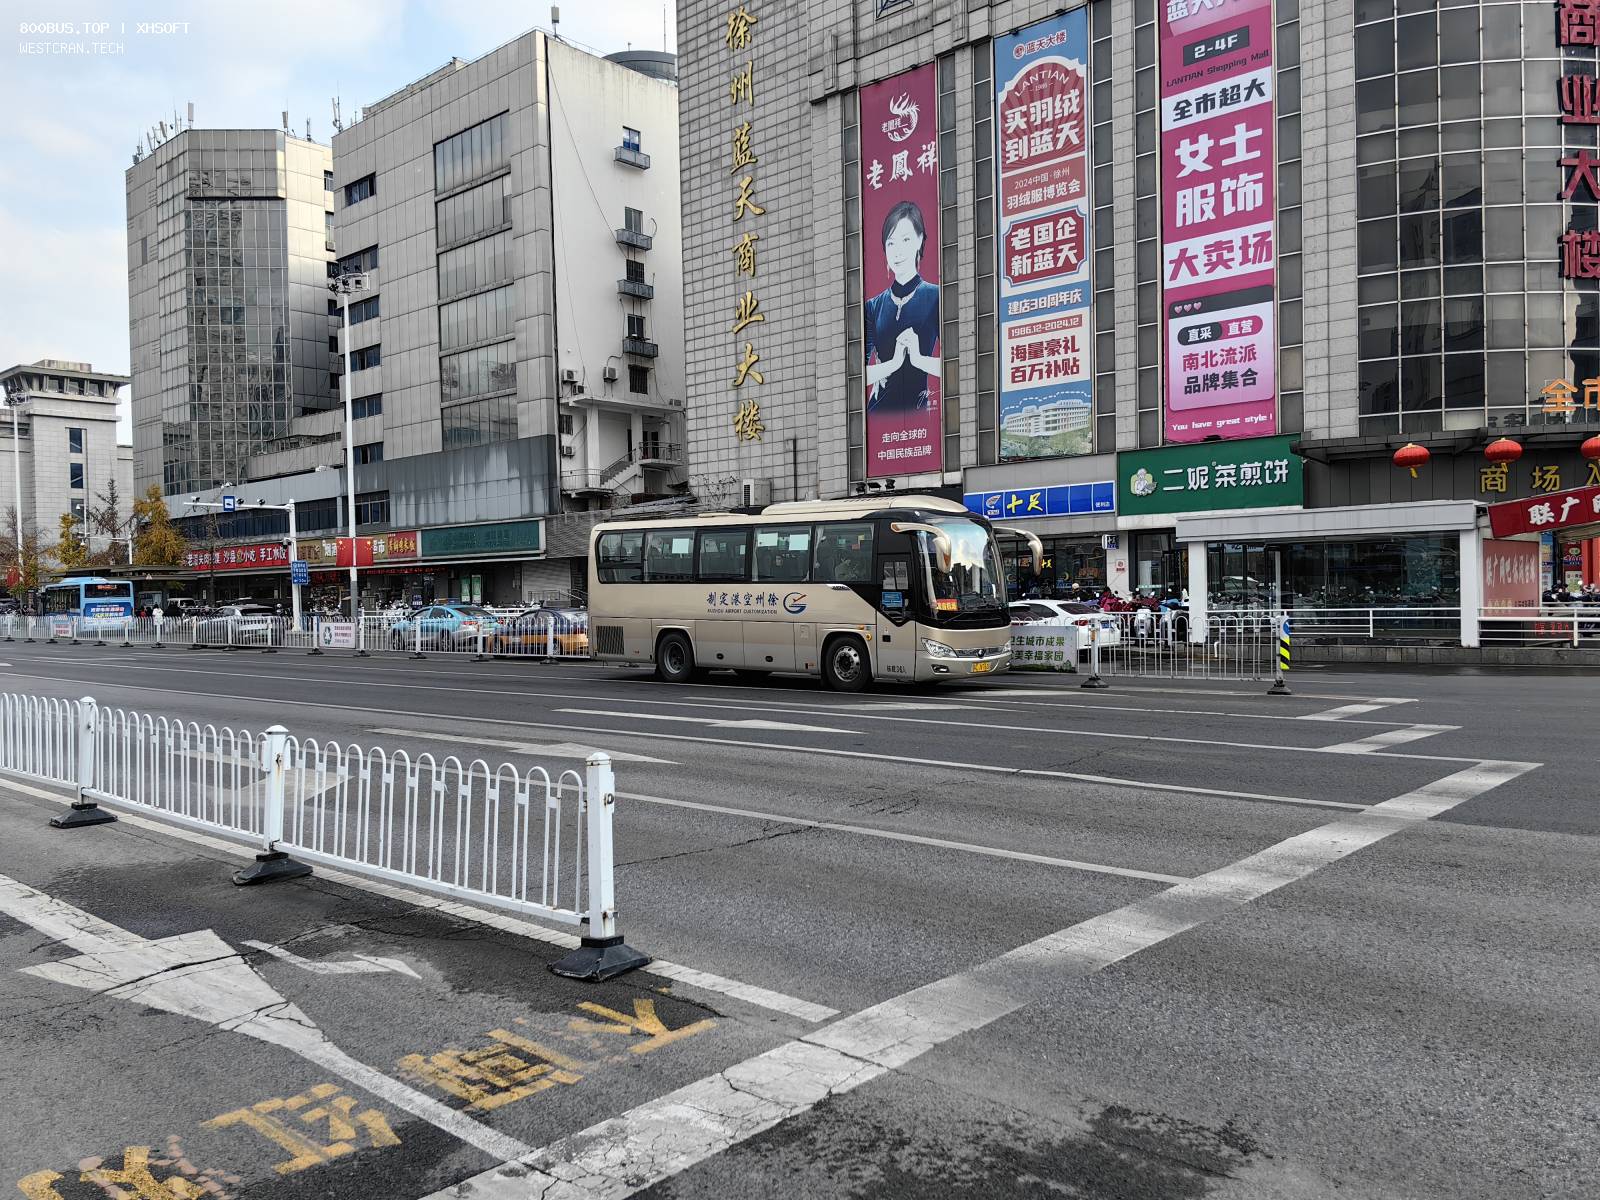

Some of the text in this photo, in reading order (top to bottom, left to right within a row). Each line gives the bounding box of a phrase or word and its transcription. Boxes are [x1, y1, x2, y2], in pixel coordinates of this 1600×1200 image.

[1026, 29, 1067, 54] 蓝天大楼
[1194, 34, 1238, 59] 2-4F
[1166, 49, 1269, 88] LANTIAN Shopping Mall
[1014, 70, 1070, 97] LANTIAN
[1005, 88, 1080, 133] 买羽绒
[1173, 78, 1266, 122] 全市超大
[1005, 120, 1080, 164] 到蓝天
[1174, 122, 1263, 178] 女士
[1007, 178, 1081, 210] 羽绒服博览会
[1175, 172, 1264, 228] 服饰
[1010, 216, 1078, 251] 老国企
[1010, 242, 1078, 277] 新蓝天
[1168, 230, 1273, 282] 大卖场
[1007, 288, 1082, 316] 建店38周年庆
[1011, 316, 1080, 337] 1986.12-2024.12
[1187, 319, 1253, 343] 直采 直营
[1010, 335, 1081, 364] 海量豪礼
[1182, 343, 1257, 373] 南北流派
[1010, 356, 1080, 384] 百万补贴
[1184, 368, 1259, 395] 品牌集合
[881, 427, 928, 444] 走向全球的
[1172, 423, 1188, 431] You
[1191, 420, 1213, 430] have
[1216, 417, 1241, 428] great
[1244, 413, 1268, 424] style
[877, 445, 932, 461] 中国民族品牌
[1162, 457, 1290, 492] 二妮菜煎饼
[1006, 491, 1044, 513] 十足
[1010, 649, 1064, 662] 美幸福家园
